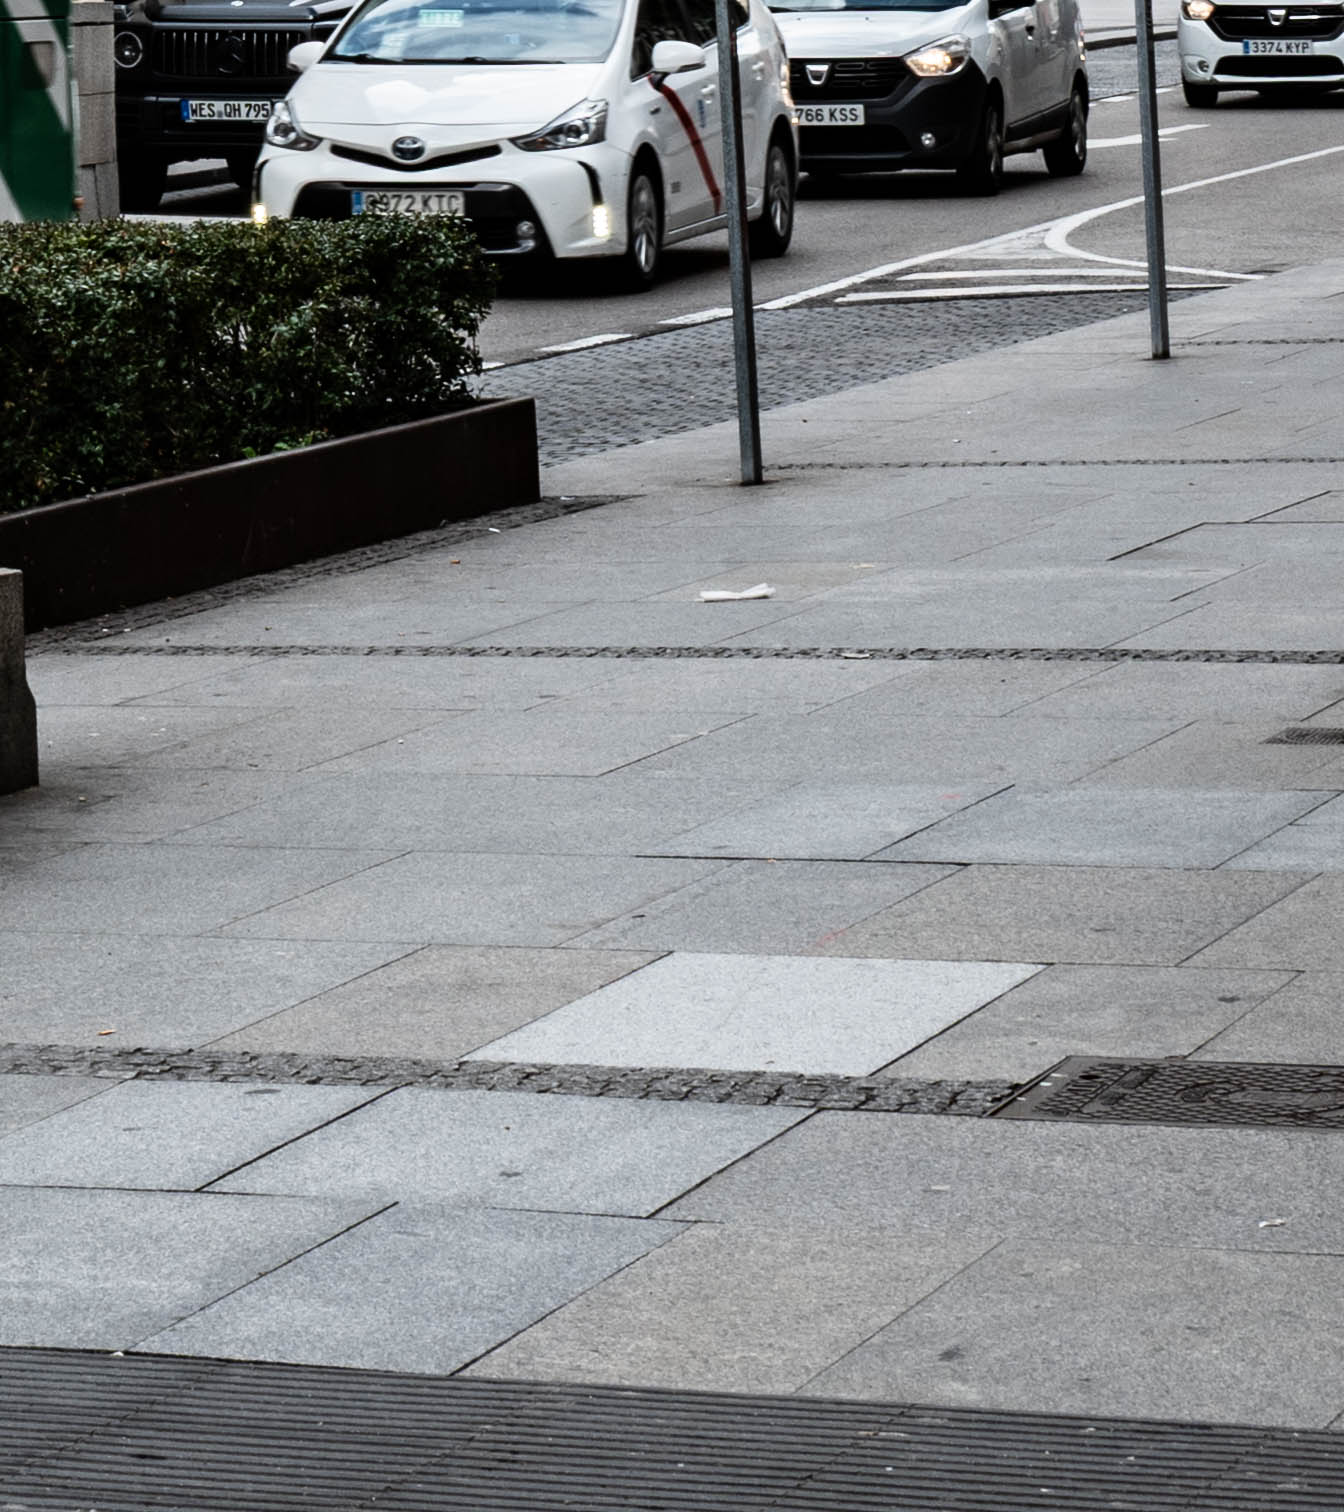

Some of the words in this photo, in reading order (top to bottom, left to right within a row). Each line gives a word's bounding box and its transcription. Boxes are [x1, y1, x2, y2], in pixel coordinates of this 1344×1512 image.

[1252, 41, 1283, 54] 3374
[1285, 41, 1310, 54] KYP
[190, 102, 216, 119] WES
[223, 102, 242, 119] QH
[244, 101, 270, 119] 795
[794, 107, 825, 123] 766
[828, 107, 859, 123] KSS
